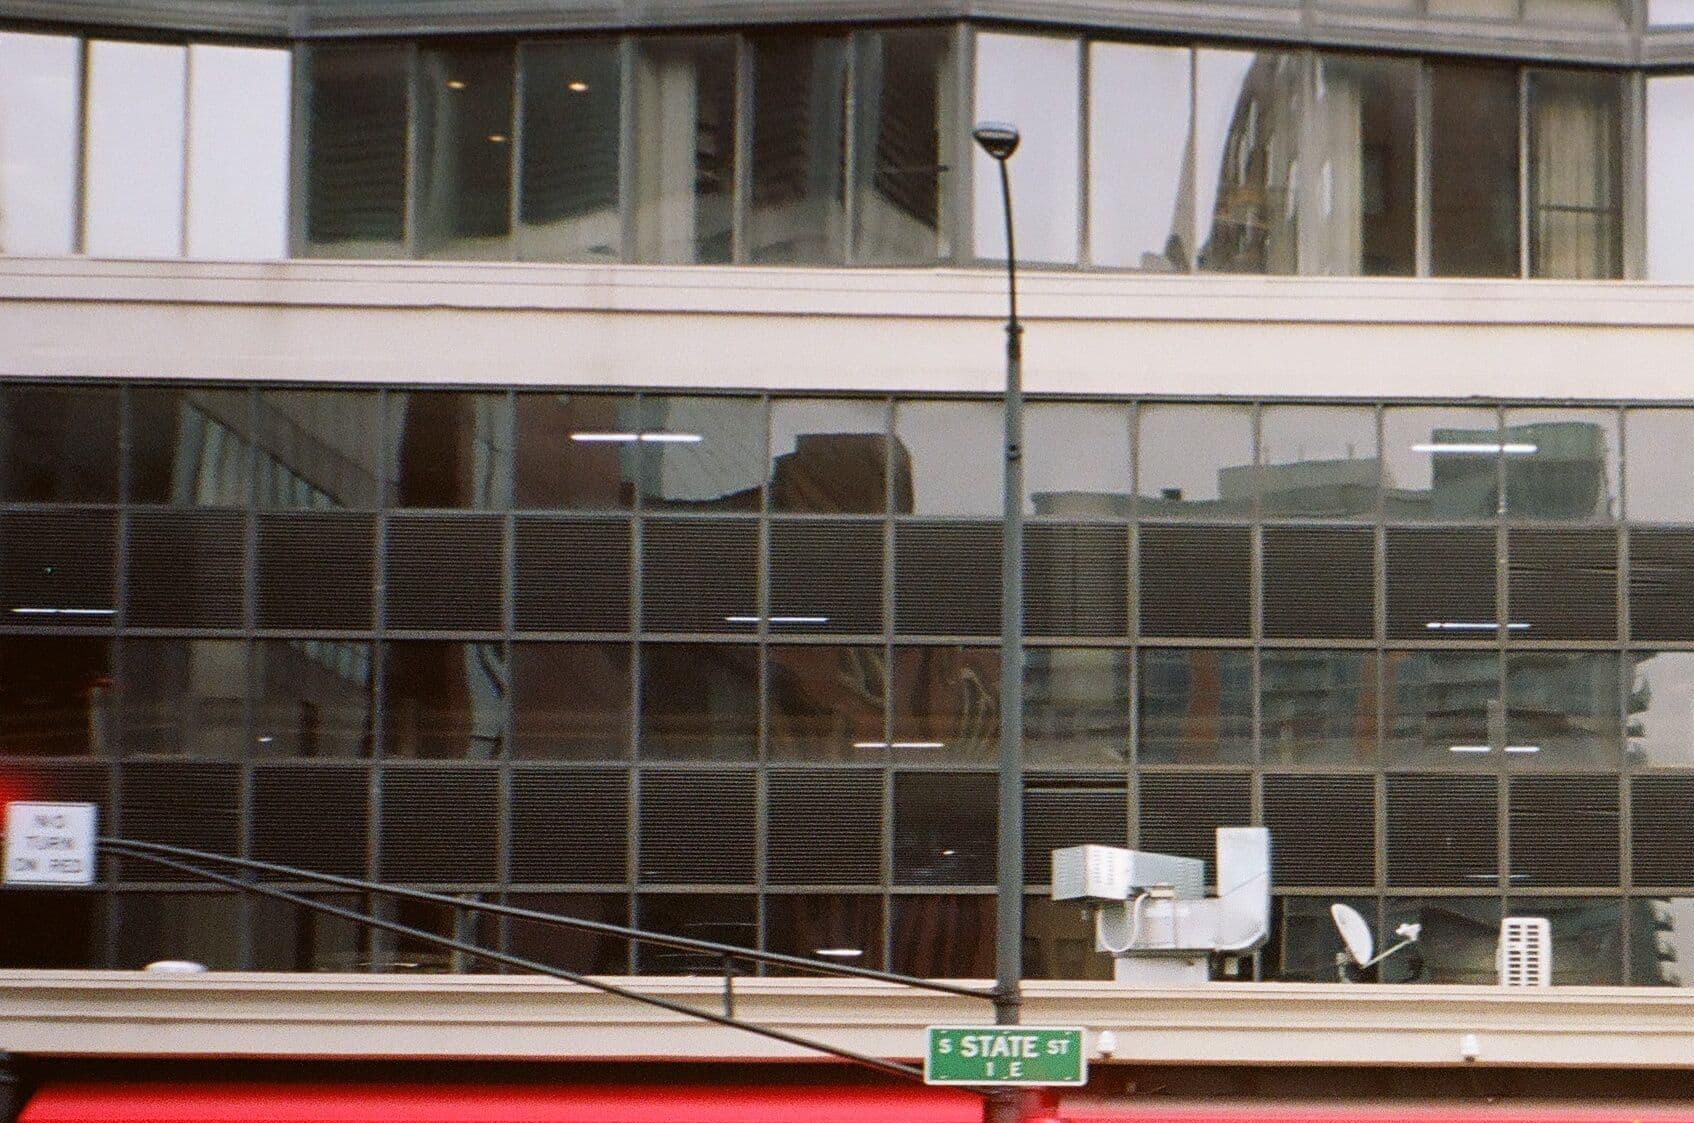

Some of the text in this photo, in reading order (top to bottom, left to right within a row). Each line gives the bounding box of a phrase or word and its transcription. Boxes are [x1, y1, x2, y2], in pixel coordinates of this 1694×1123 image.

[35, 814, 65, 829] NO
[24, 834, 77, 851] TURN
[14, 857, 83, 875] ON RED
[938, 1035, 1070, 1058] S STATE ST
[1009, 1062, 1023, 1078] E
